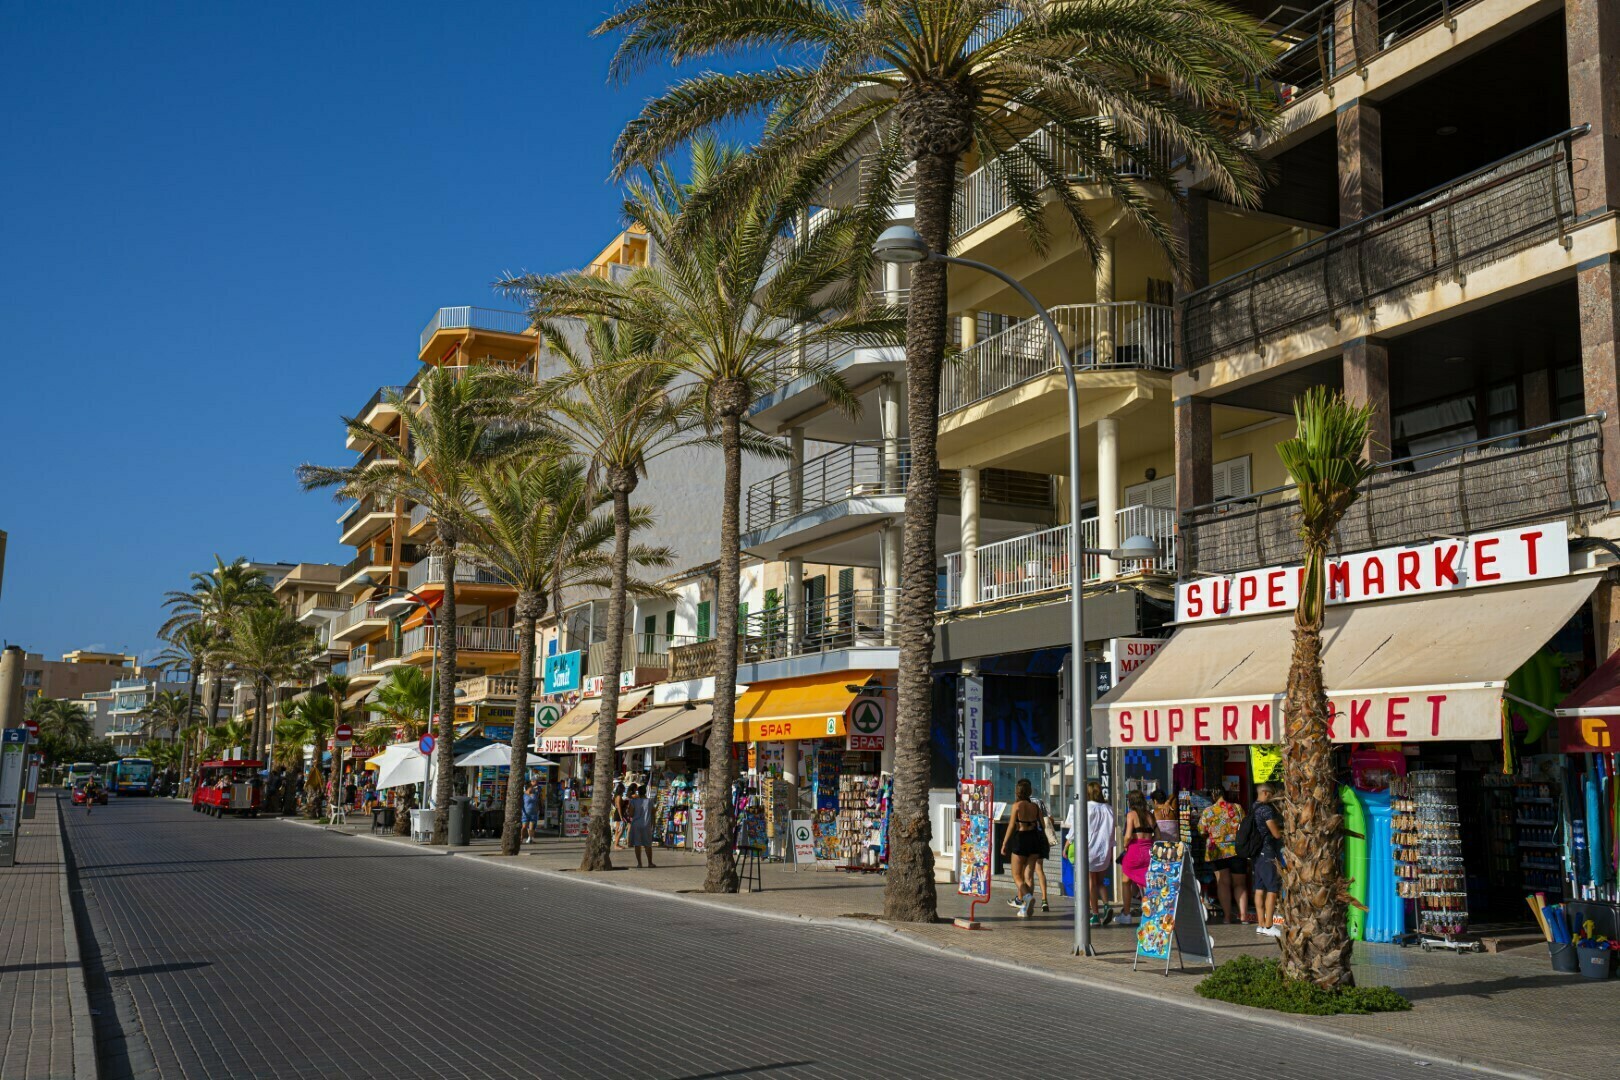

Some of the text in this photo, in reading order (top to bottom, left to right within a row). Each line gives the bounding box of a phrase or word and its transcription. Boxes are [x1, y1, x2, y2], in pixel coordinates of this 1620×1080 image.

[1186, 531, 1543, 618] SUPEMARKET
[760, 723, 791, 737] SPAR
[850, 736, 884, 749] SPAR
[695, 810, 704, 821] 3
